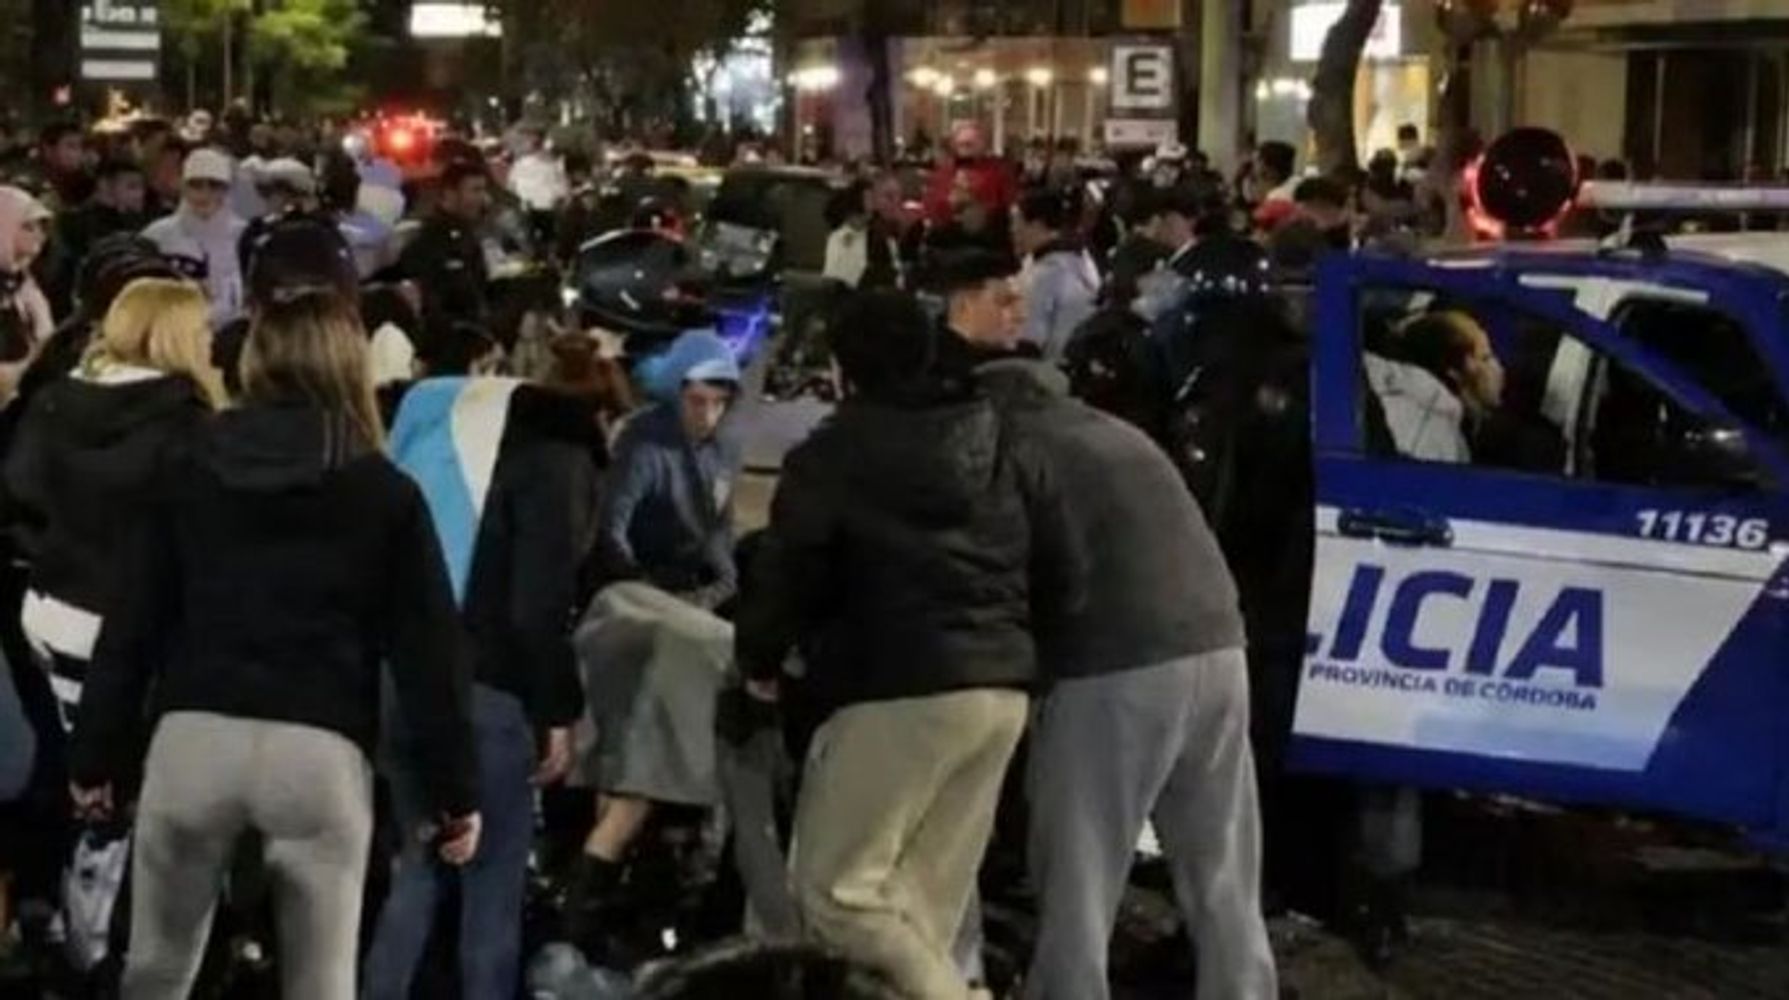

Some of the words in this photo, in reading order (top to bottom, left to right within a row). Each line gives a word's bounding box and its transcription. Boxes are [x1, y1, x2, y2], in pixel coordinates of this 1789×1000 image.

[1127, 53, 1159, 95] E
[1637, 510, 1768, 548] 11136
[1309, 664, 1436, 692] PROVINCIA
[1444, 677, 1475, 697] DE
